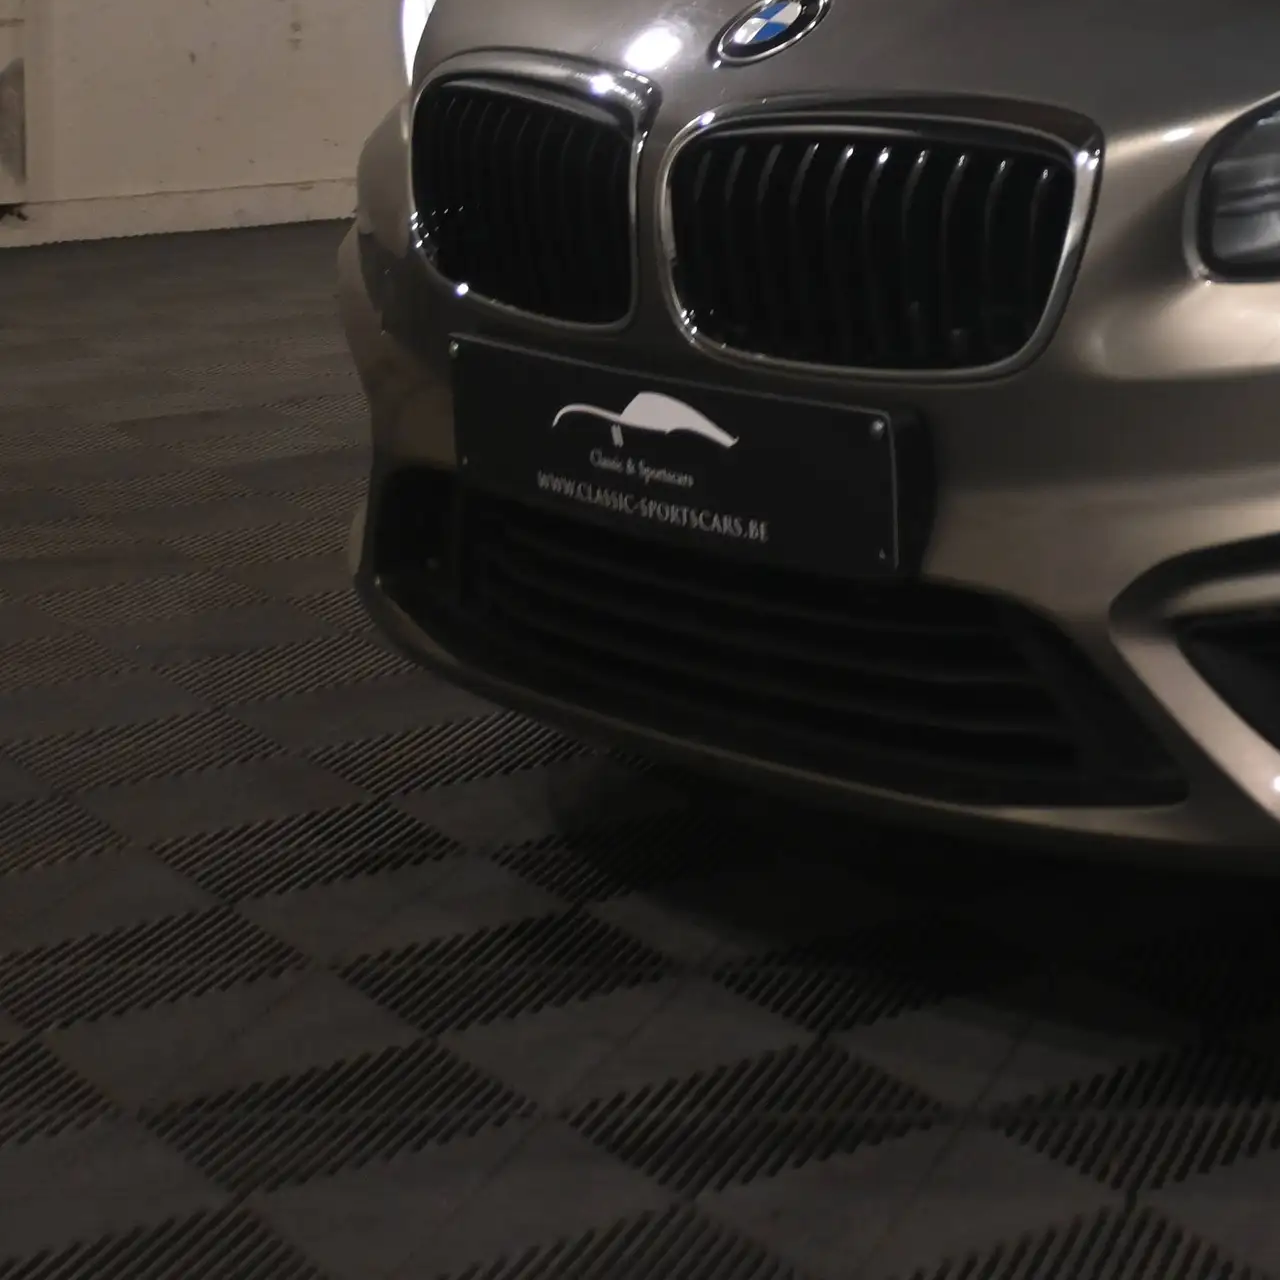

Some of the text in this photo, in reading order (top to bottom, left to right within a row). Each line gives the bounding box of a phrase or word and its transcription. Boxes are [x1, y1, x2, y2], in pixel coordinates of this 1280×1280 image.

[589, 447, 695, 489] Classic & Sportscars
[536, 469, 770, 543] WWW.CLASSIC-SPORTSCARS.BE
